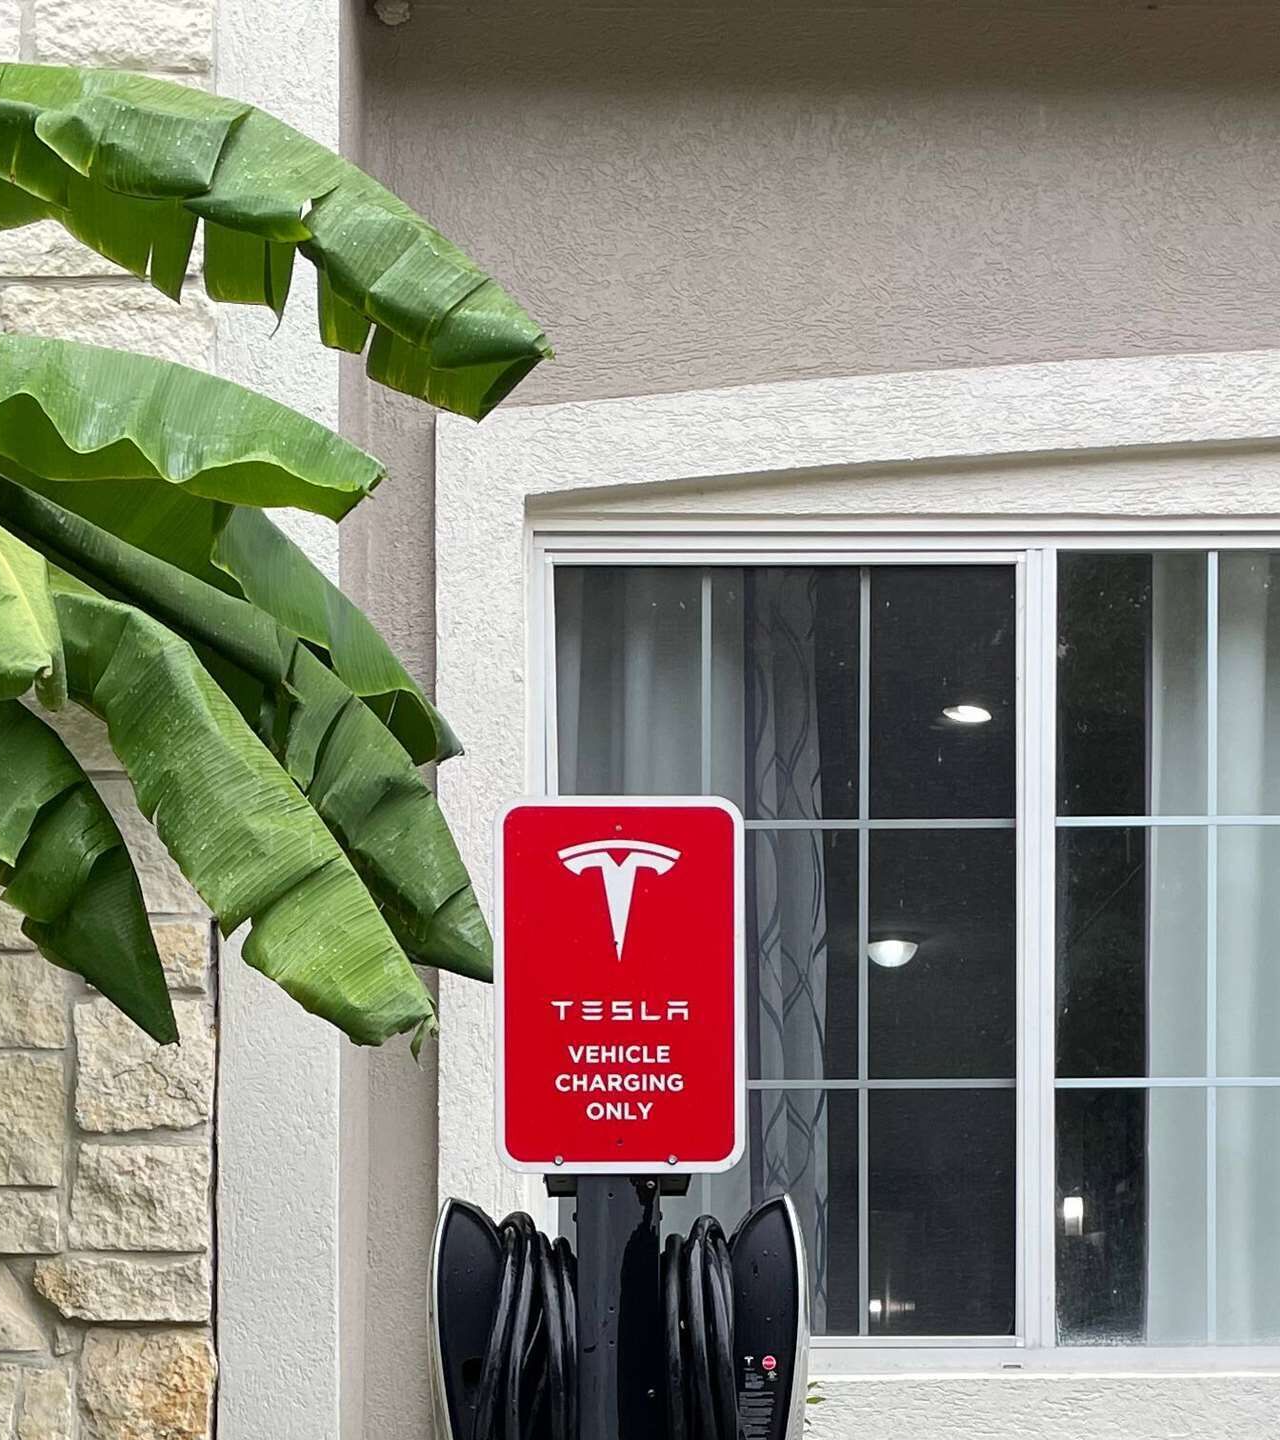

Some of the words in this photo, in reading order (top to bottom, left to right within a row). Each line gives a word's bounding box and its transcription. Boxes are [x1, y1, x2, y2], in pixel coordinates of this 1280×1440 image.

[551, 1000, 689, 1021] TESLA
[568, 1045, 670, 1064] VEHICLE
[555, 1073, 684, 1092] CHARGING
[586, 1102, 653, 1121] ONLY
